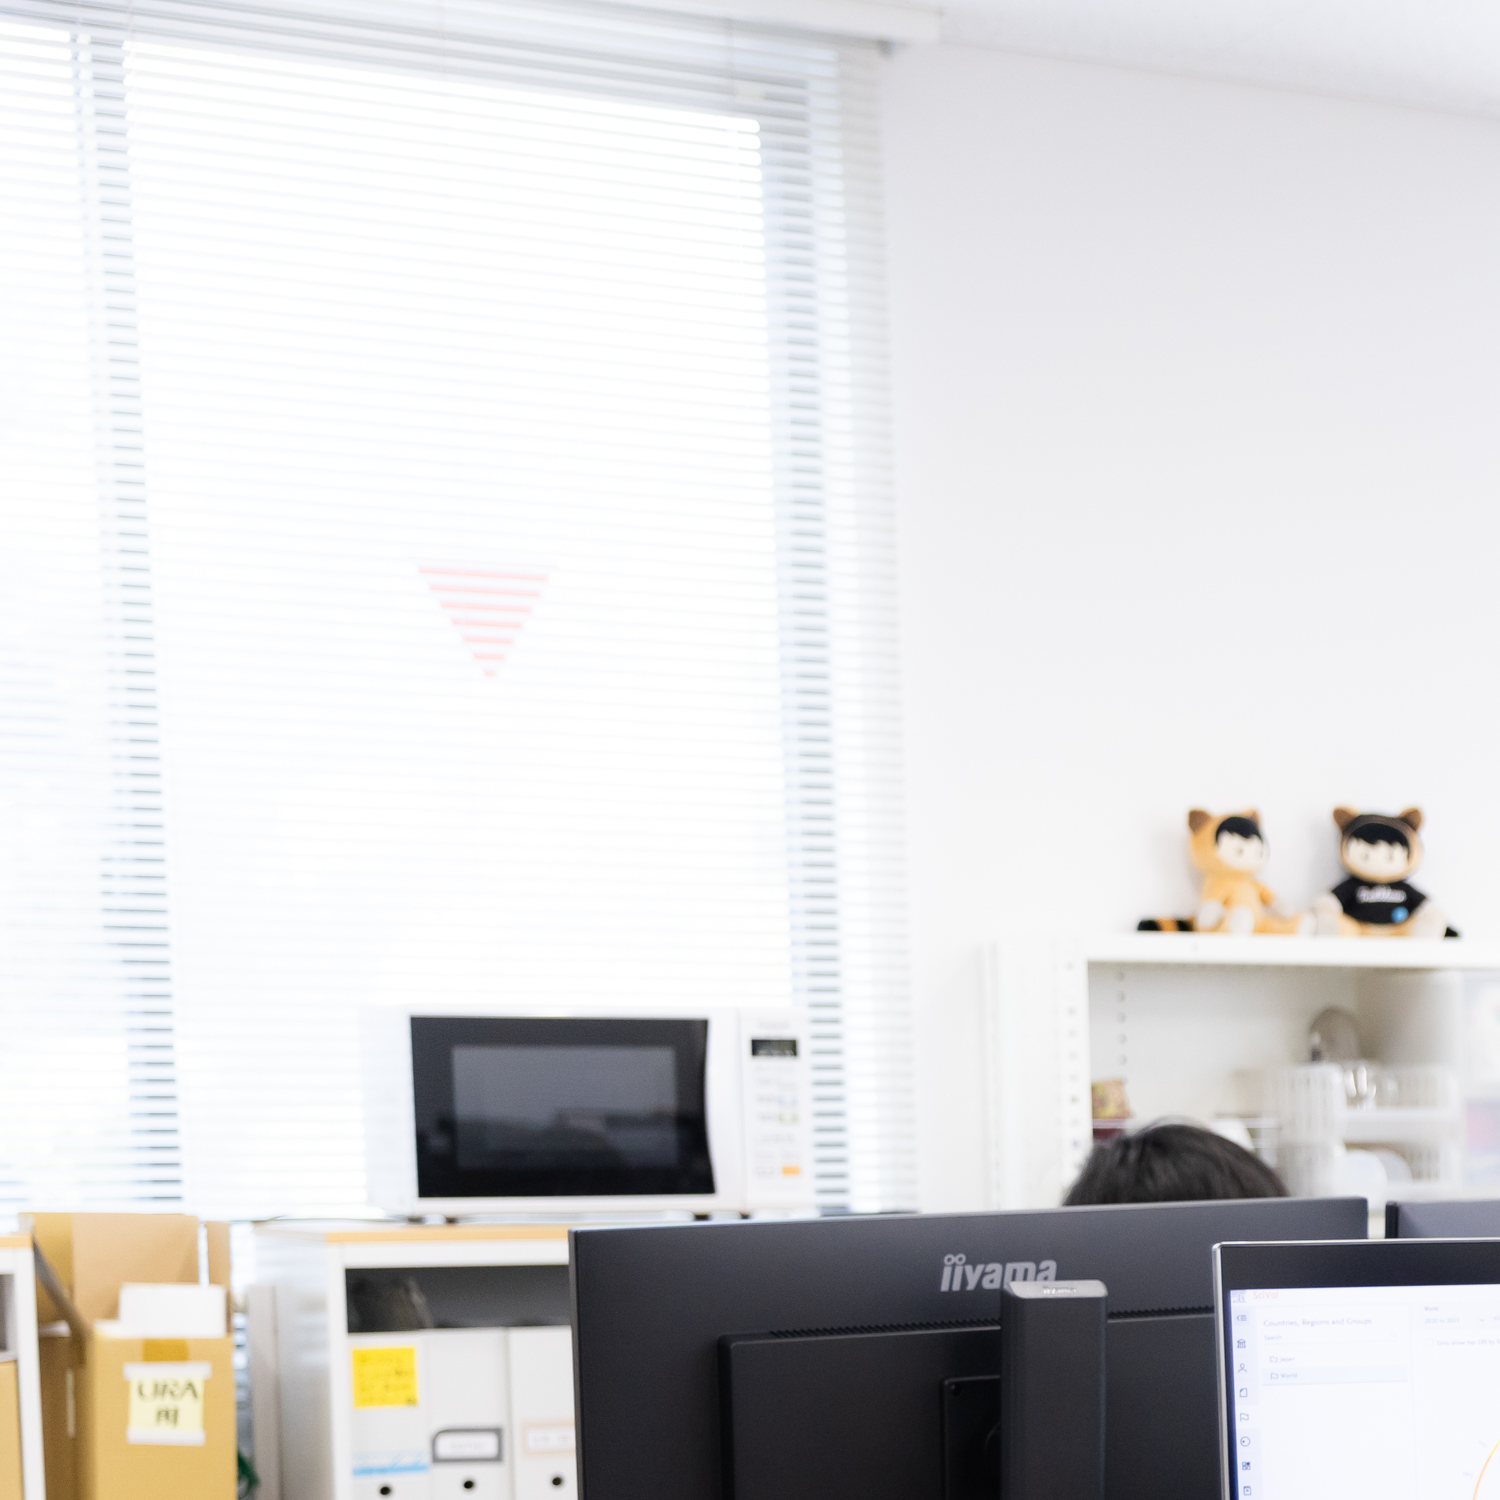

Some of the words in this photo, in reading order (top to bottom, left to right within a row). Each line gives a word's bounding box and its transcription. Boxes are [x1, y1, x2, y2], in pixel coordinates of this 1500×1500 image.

[940, 1253, 1058, 1293] iiyama
[1253, 1290, 1280, 1300] SciVal
[1263, 1318, 1301, 1329] Countries,
[1301, 1317, 1331, 1329] Regions
[1332, 1317, 1345, 1326] and
[1346, 1317, 1373, 1327] Groups
[1264, 1334, 1283, 1342] Search
[137, 1380, 199, 1402] URA
